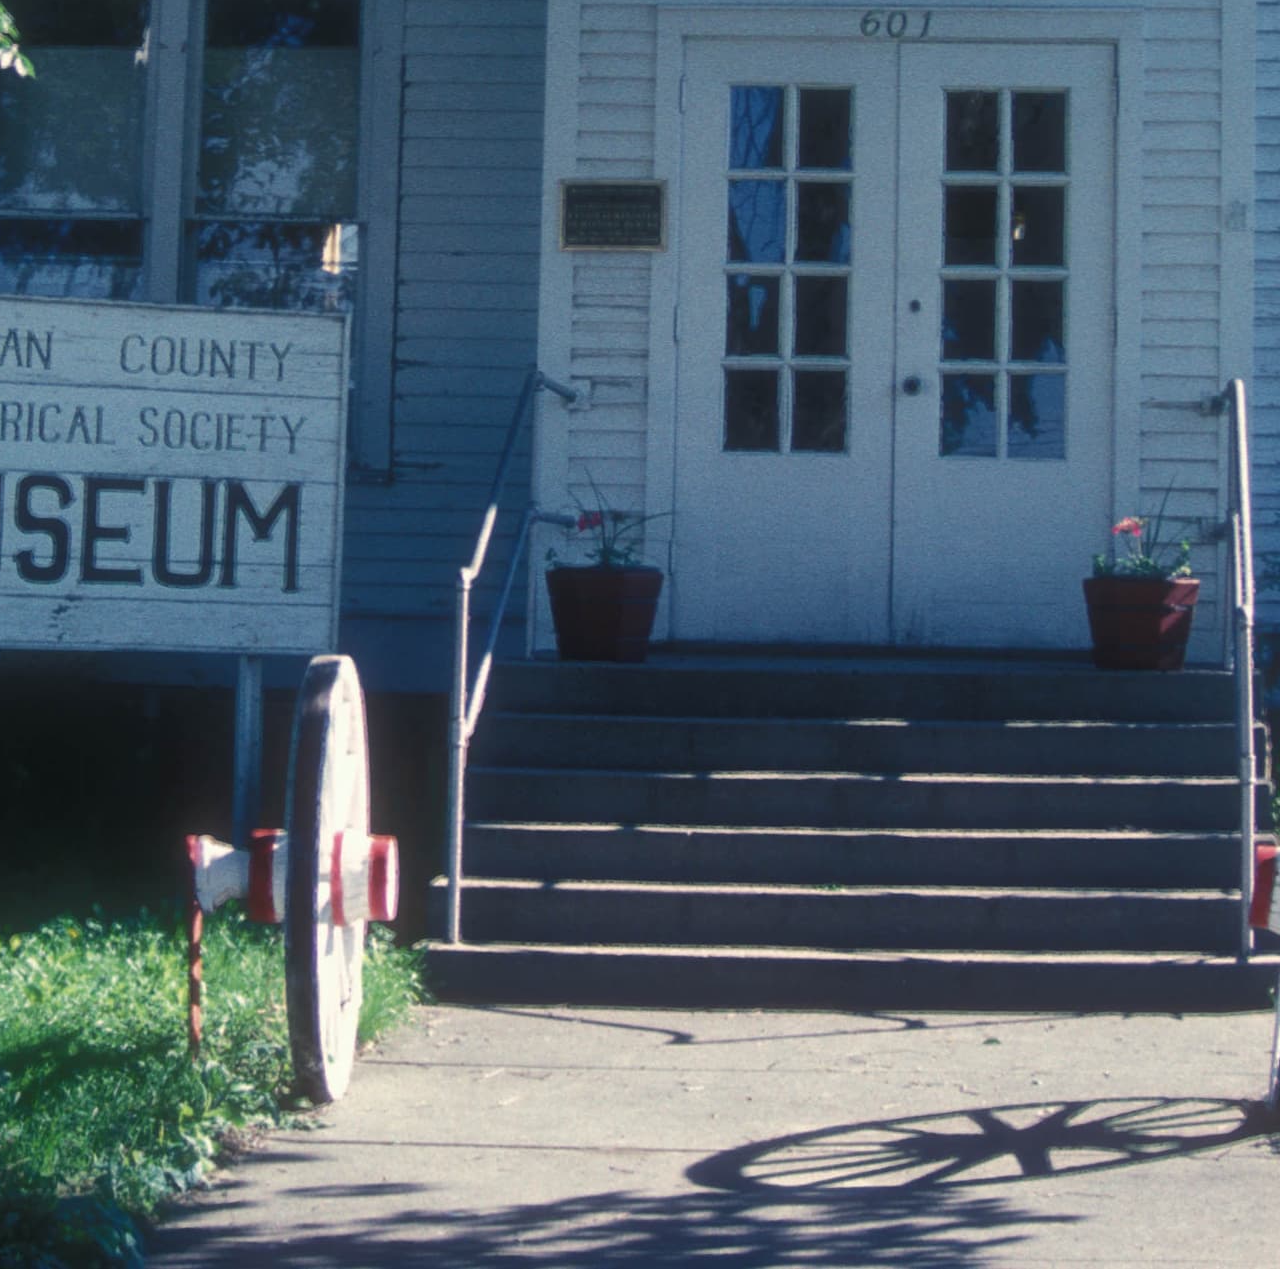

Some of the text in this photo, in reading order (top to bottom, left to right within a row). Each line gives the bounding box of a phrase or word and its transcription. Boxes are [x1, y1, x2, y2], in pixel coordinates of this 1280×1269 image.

[861, 10, 932, 39] 601
[120, 334, 294, 382] COUNTY
[138, 407, 307, 454] SOCIETY
